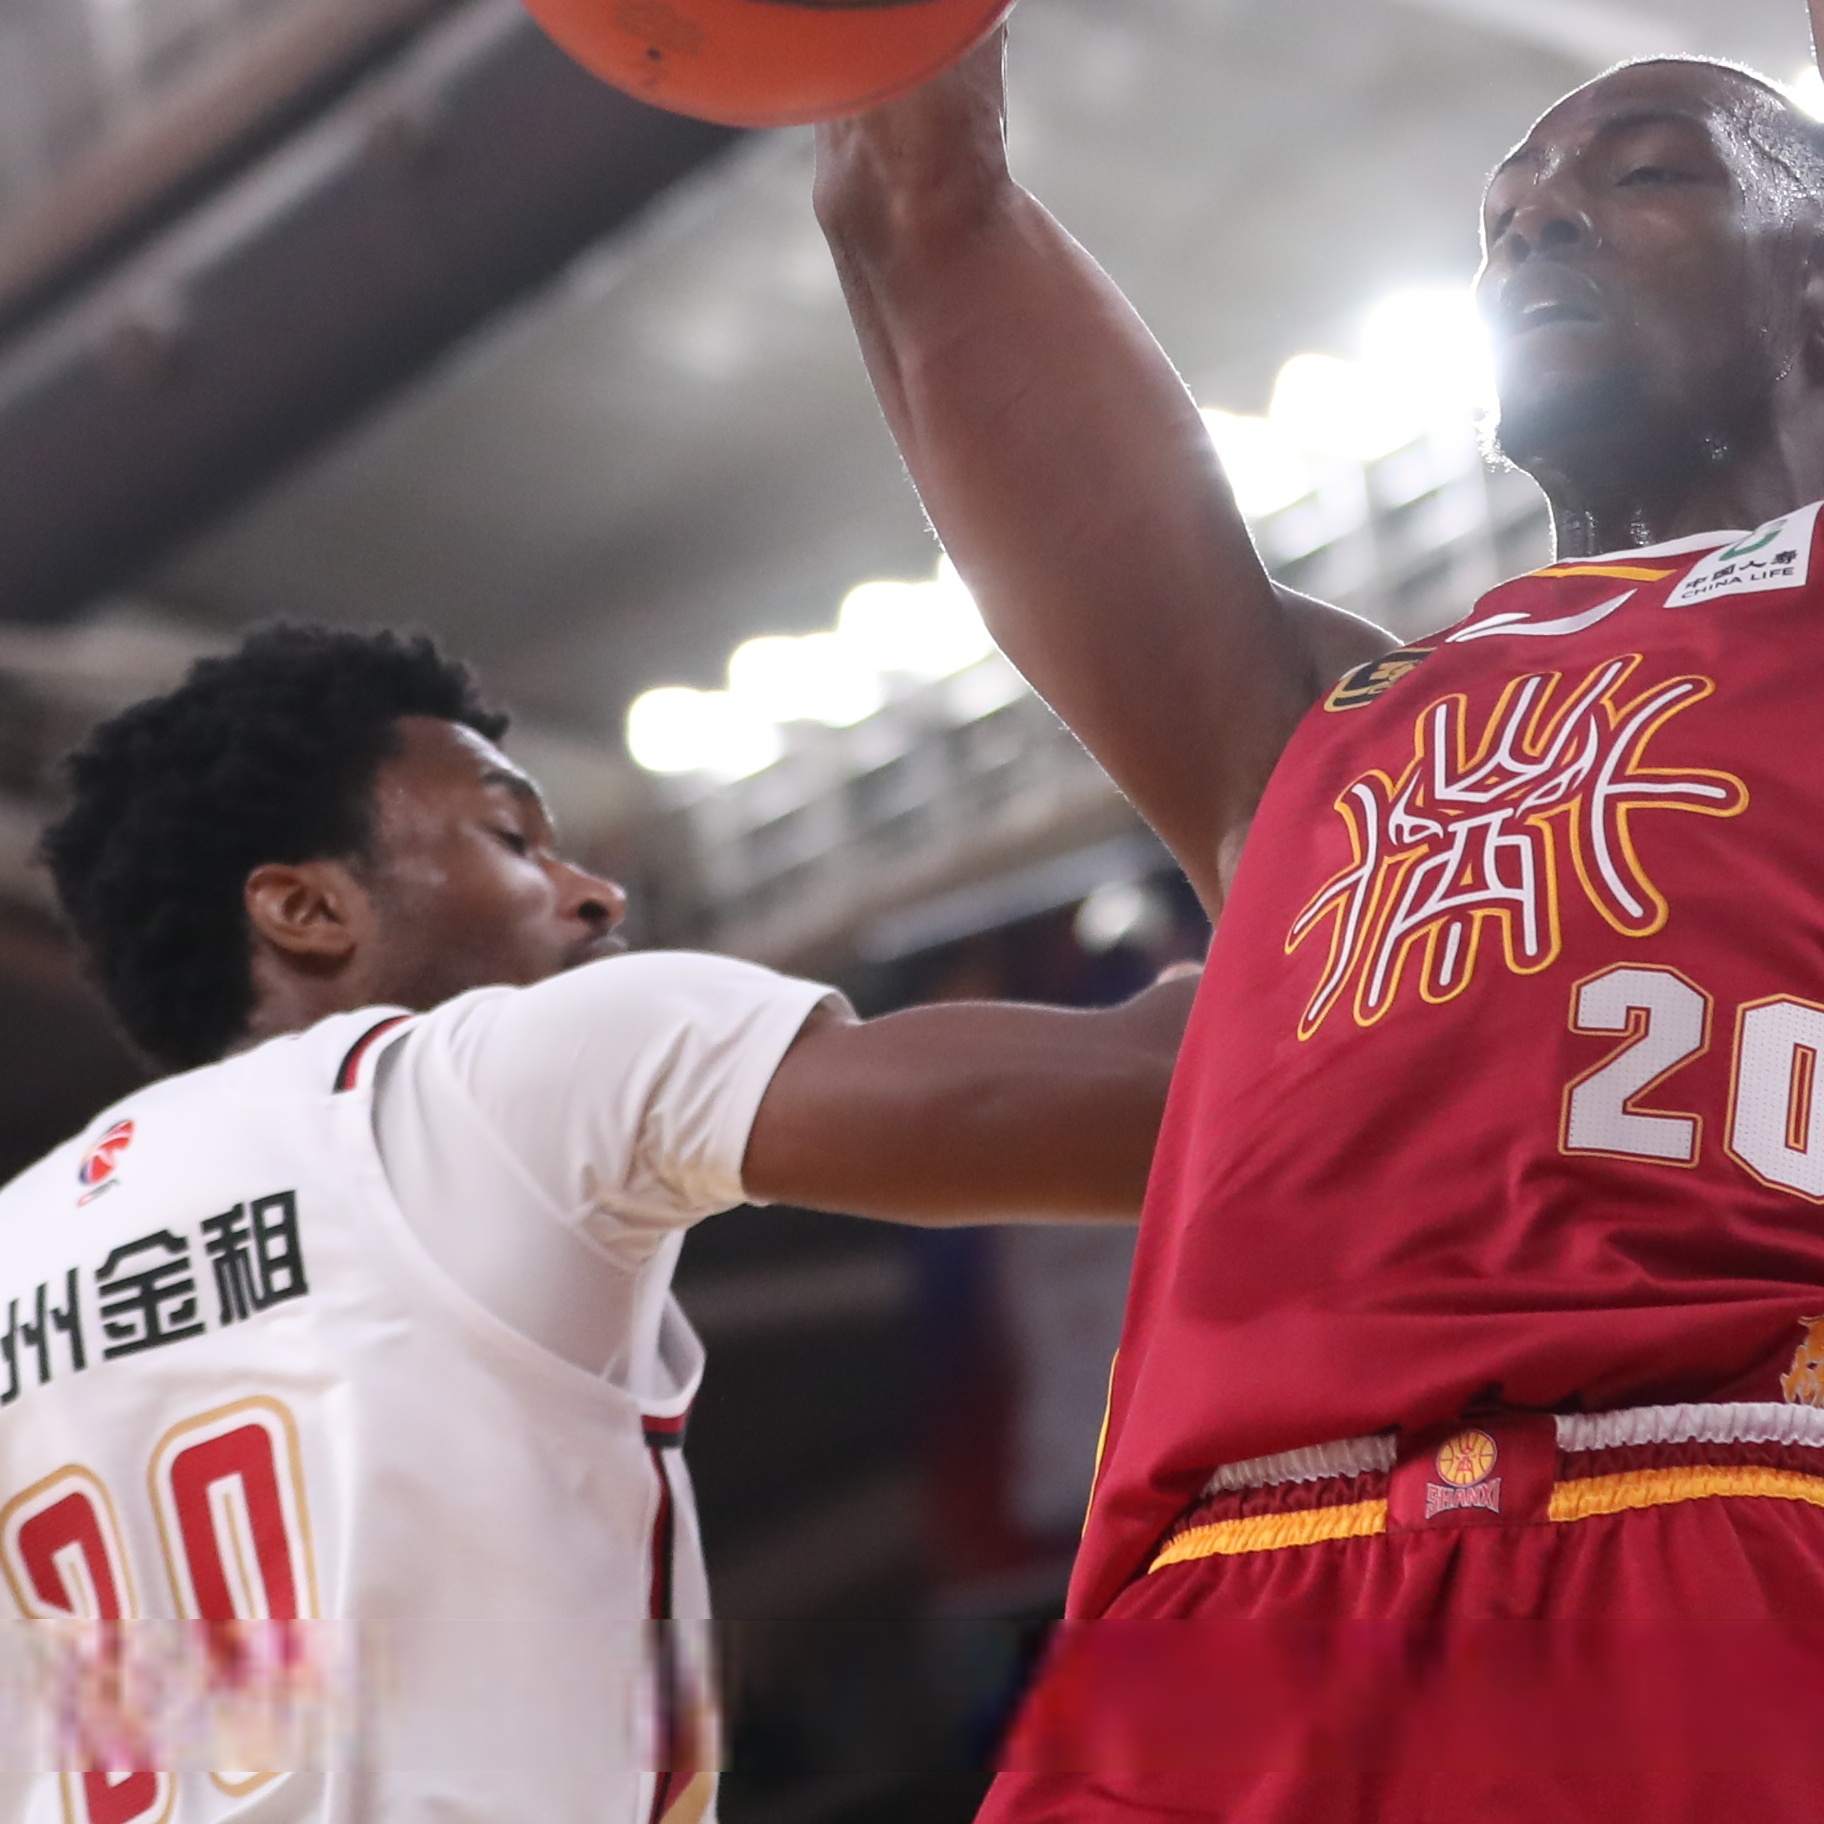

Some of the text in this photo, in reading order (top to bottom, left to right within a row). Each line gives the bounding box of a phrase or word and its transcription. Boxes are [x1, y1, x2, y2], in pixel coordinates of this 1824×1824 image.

[1680, 566, 1795, 600] CHINA LIFE
[1425, 1477, 1502, 1520] SHANXI
